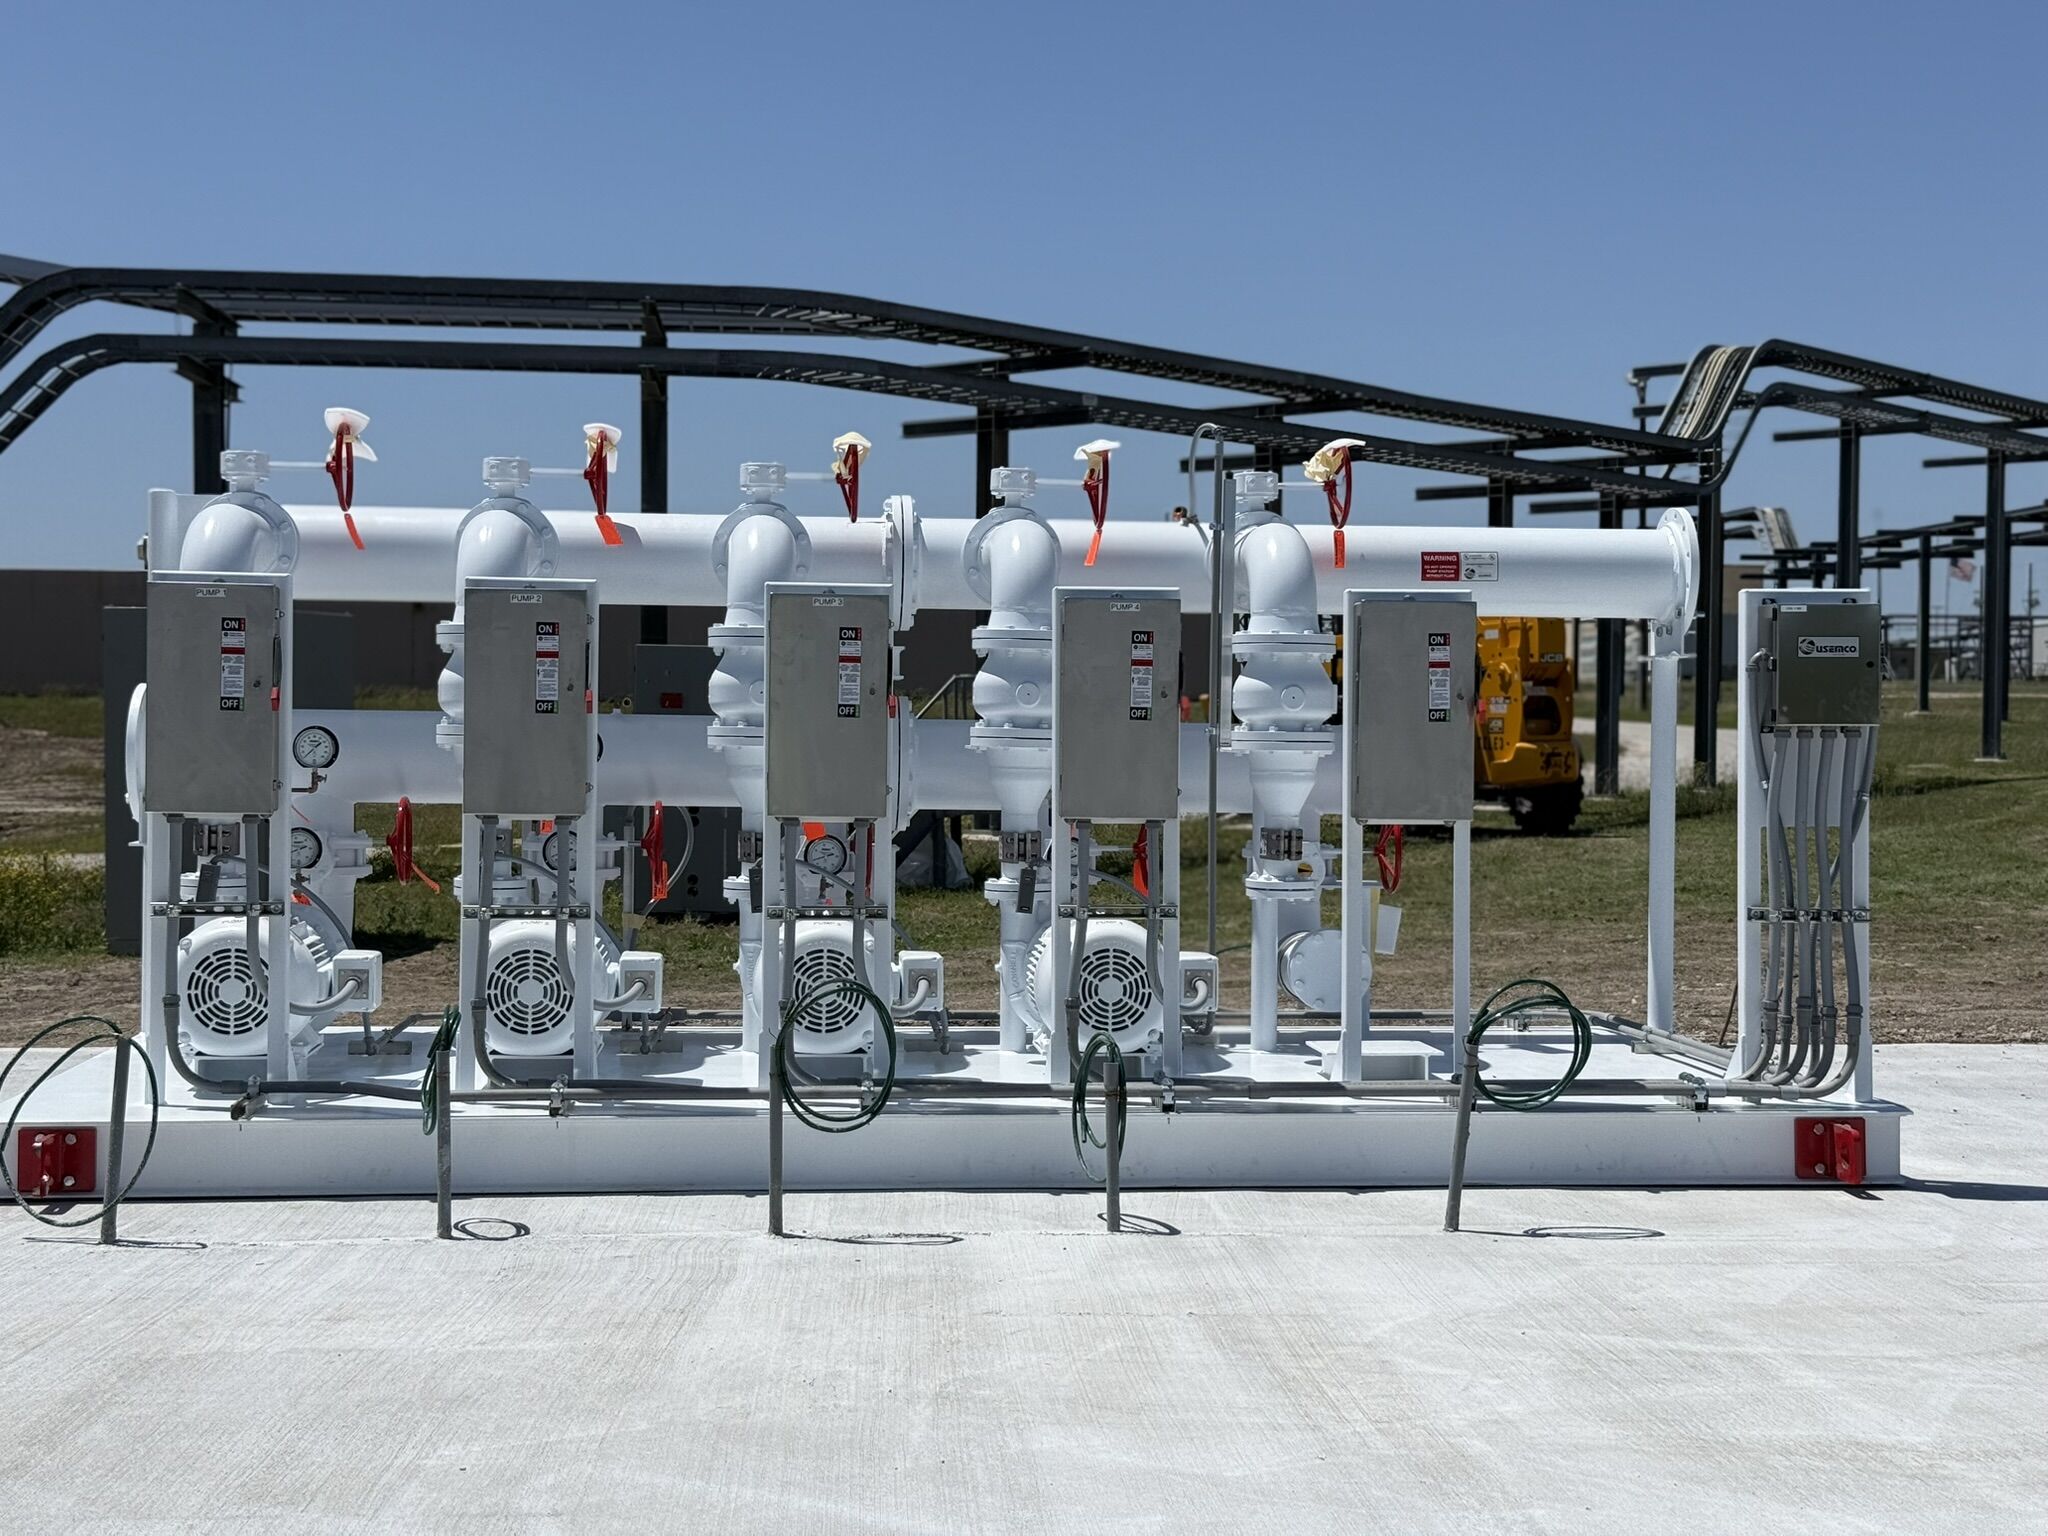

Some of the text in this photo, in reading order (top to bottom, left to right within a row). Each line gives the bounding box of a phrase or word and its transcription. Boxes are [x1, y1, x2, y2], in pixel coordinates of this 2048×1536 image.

[196, 588, 220, 596] PUMP
[511, 594, 542, 602] PUMP 2
[813, 598, 836, 606] PUMP
[223, 620, 239, 629] ON
[538, 624, 553, 634] ON
[841, 629, 855, 639] ON
[1133, 633, 1148, 642] ON
[1430, 635, 1445, 645] ON
[1540, 654, 1563, 663] JCB
[221, 699, 239, 708] OFF
[536, 702, 553, 711] OFF
[838, 706, 855, 715] OFF
[1130, 709, 1147, 718] OFF
[1429, 710, 1446, 720] OFF
